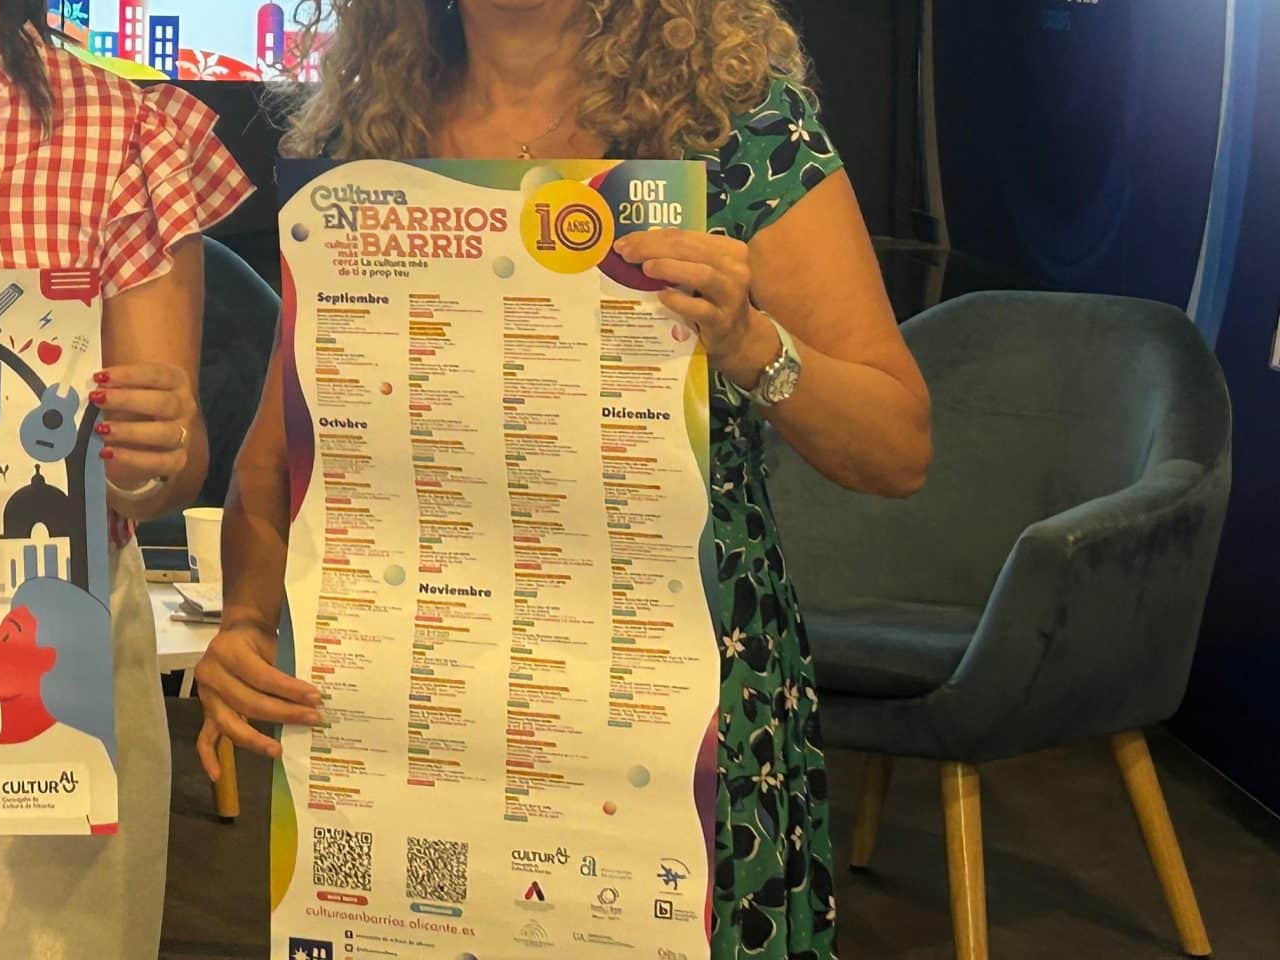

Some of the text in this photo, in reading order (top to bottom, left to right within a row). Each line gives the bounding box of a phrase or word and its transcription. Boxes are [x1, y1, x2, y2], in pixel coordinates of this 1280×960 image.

[311, 184, 408, 212] Cultura
[629, 179, 667, 201] OCT
[323, 203, 508, 232] EN BARRIOS
[619, 202, 682, 224] 20 DIC
[535, 203, 603, 251] 10
[360, 233, 483, 259] BARRIS
[361, 257, 371, 266] La
[374, 257, 406, 267] cultura
[369, 268, 392, 278] prop
[394, 267, 410, 277] teu
[317, 292, 390, 305] Septiembre
[601, 407, 671, 421] Diciembre
[319, 417, 368, 430] Octubre
[419, 583, 493, 598] Noviembre
